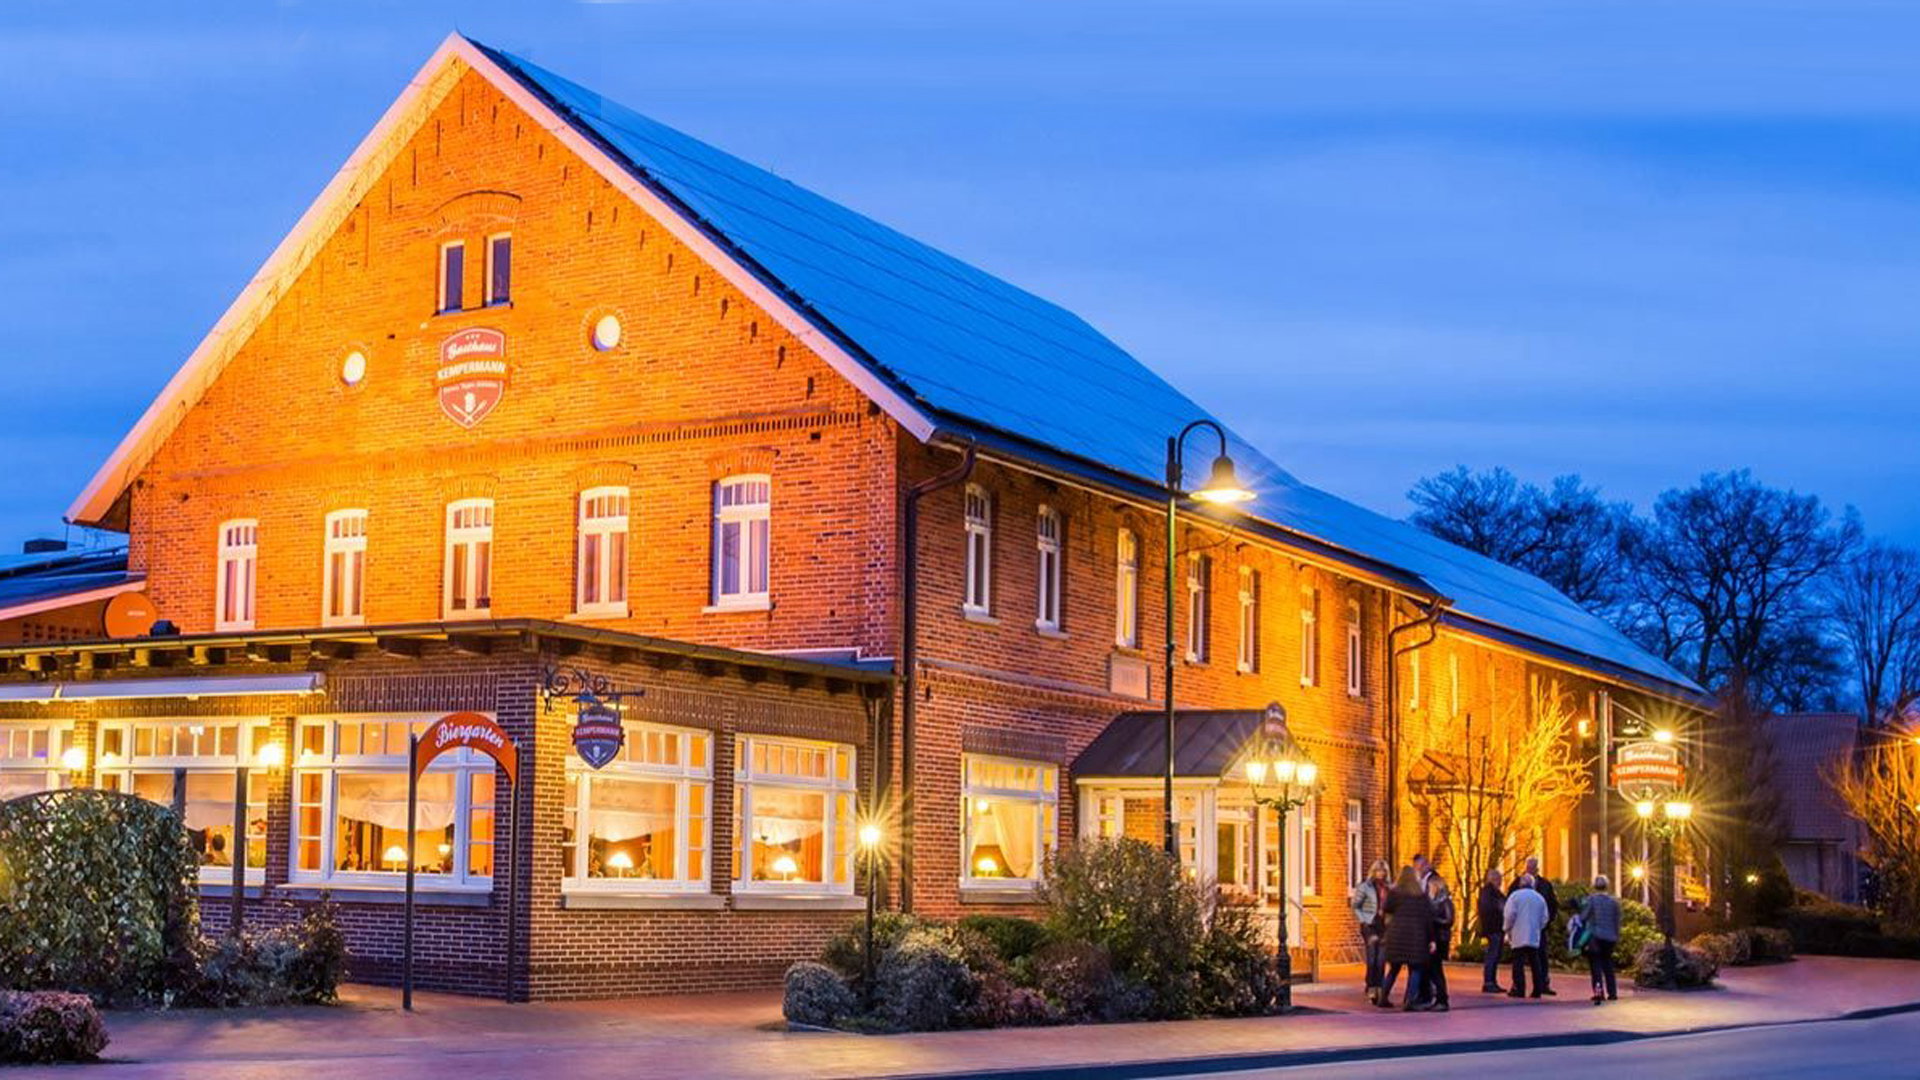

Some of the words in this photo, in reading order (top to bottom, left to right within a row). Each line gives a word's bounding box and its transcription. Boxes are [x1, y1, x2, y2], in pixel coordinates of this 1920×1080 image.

[447, 340, 498, 360] Gasthaus
[436, 360, 506, 381] KEMPERMANN
[435, 722, 504, 748] Biergarten
